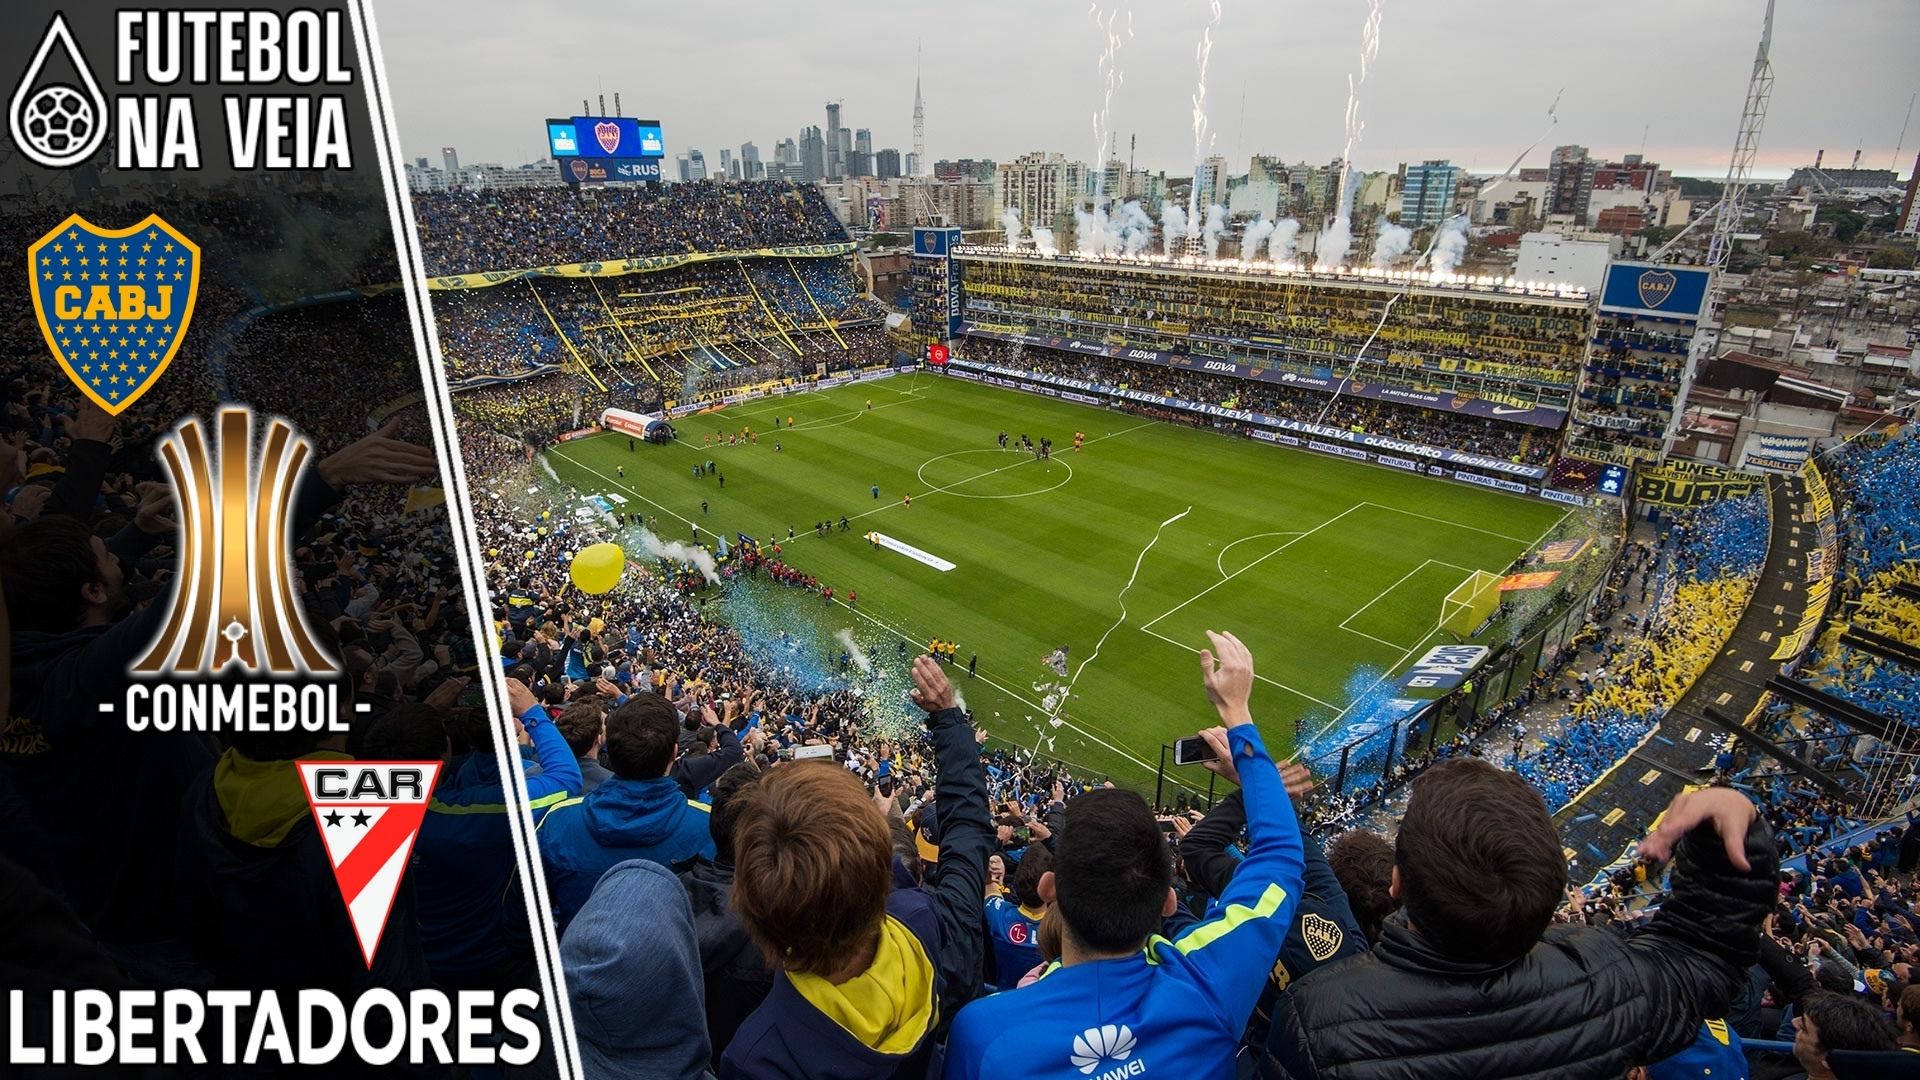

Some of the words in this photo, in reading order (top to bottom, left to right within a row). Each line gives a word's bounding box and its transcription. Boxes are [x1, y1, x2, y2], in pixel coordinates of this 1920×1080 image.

[632, 164, 659, 176] RUS
[1642, 282, 1670, 292] CABJ
[950, 284, 961, 317] BBVA
[1540, 319, 1571, 331] BOCA
[1127, 348, 1158, 361] BBVA
[1203, 360, 1237, 373] BBVA
[1041, 374, 1056, 384] LA
[1057, 377, 1092, 391] NUEVA
[1296, 376, 1328, 386] HUAWEI
[1109, 388, 1126, 397] LA
[1126, 390, 1167, 405] NUEVA
[1188, 401, 1206, 412] LA
[1207, 404, 1254, 421] NUEVA
[1279, 419, 1300, 431] LA
[1301, 423, 1355, 441] NUEVA
[1604, 416, 1641, 430] FAMILIA
[1310, 441, 1340, 454] PINTURAS
[1340, 447, 1365, 460] Talento
[1567, 445, 1630, 468] PATERNAL
[1380, 456, 1412, 469] PINTURAS
[1663, 459, 1729, 479] FUNES
[1747, 456, 1800, 470] VERSAILLES
[1457, 472, 1492, 486] PINTURAS
[1493, 480, 1524, 493] Talento
[1306, 925, 1337, 945] CABJ
